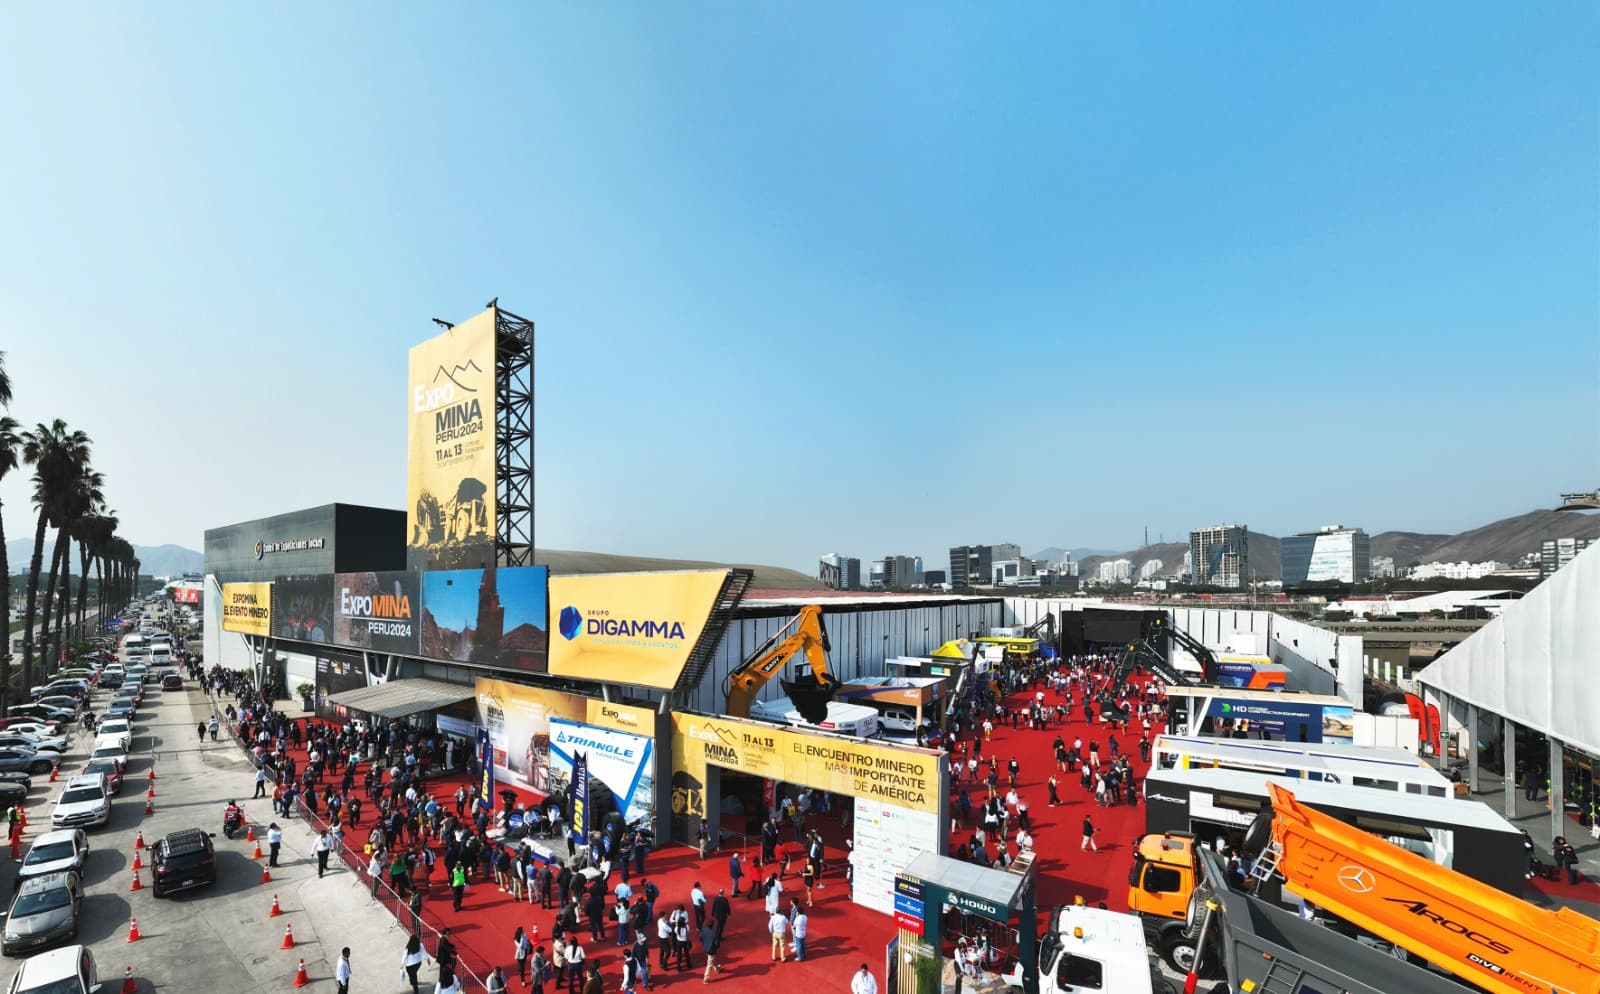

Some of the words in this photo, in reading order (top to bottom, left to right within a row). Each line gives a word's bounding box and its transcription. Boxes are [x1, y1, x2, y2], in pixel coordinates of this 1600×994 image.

[436, 398, 483, 433] MINA
[436, 421, 483, 444] PERU2024
[436, 449, 442, 461] 11
[443, 448, 453, 459] AL
[454, 443, 463, 456] 13
[233, 593, 258, 605] EXPOMINA
[224, 605, 229, 615] EL
[230, 606, 248, 617] EVENTO
[249, 607, 269, 619] MINERO
[368, 622, 411, 637] PERU2024
[587, 619, 685, 640] DIGAMMA
[765, 656, 780, 672] SANY
[1232, 705, 1247, 713] HD
[567, 735, 634, 758] TRIANGLE
[743, 733, 751, 742] 11
[752, 737, 762, 745] AL
[764, 737, 774, 747] 13
[704, 743, 738, 759] MINA
[705, 753, 739, 765] PERU2024
[793, 743, 805, 754] EL
[806, 745, 873, 766] ENCUENTRO
[875, 758, 924, 776] MINERO
[850, 766, 926, 790] IMPORTANTE
[854, 780, 868, 792] DE
[870, 784, 926, 804] AMÉRICA
[960, 897, 996, 914] HOWO
[1381, 897, 1514, 955] AROCS
[1469, 954, 1502, 974] DIVE
[1505, 972, 1543, 992] RENT
